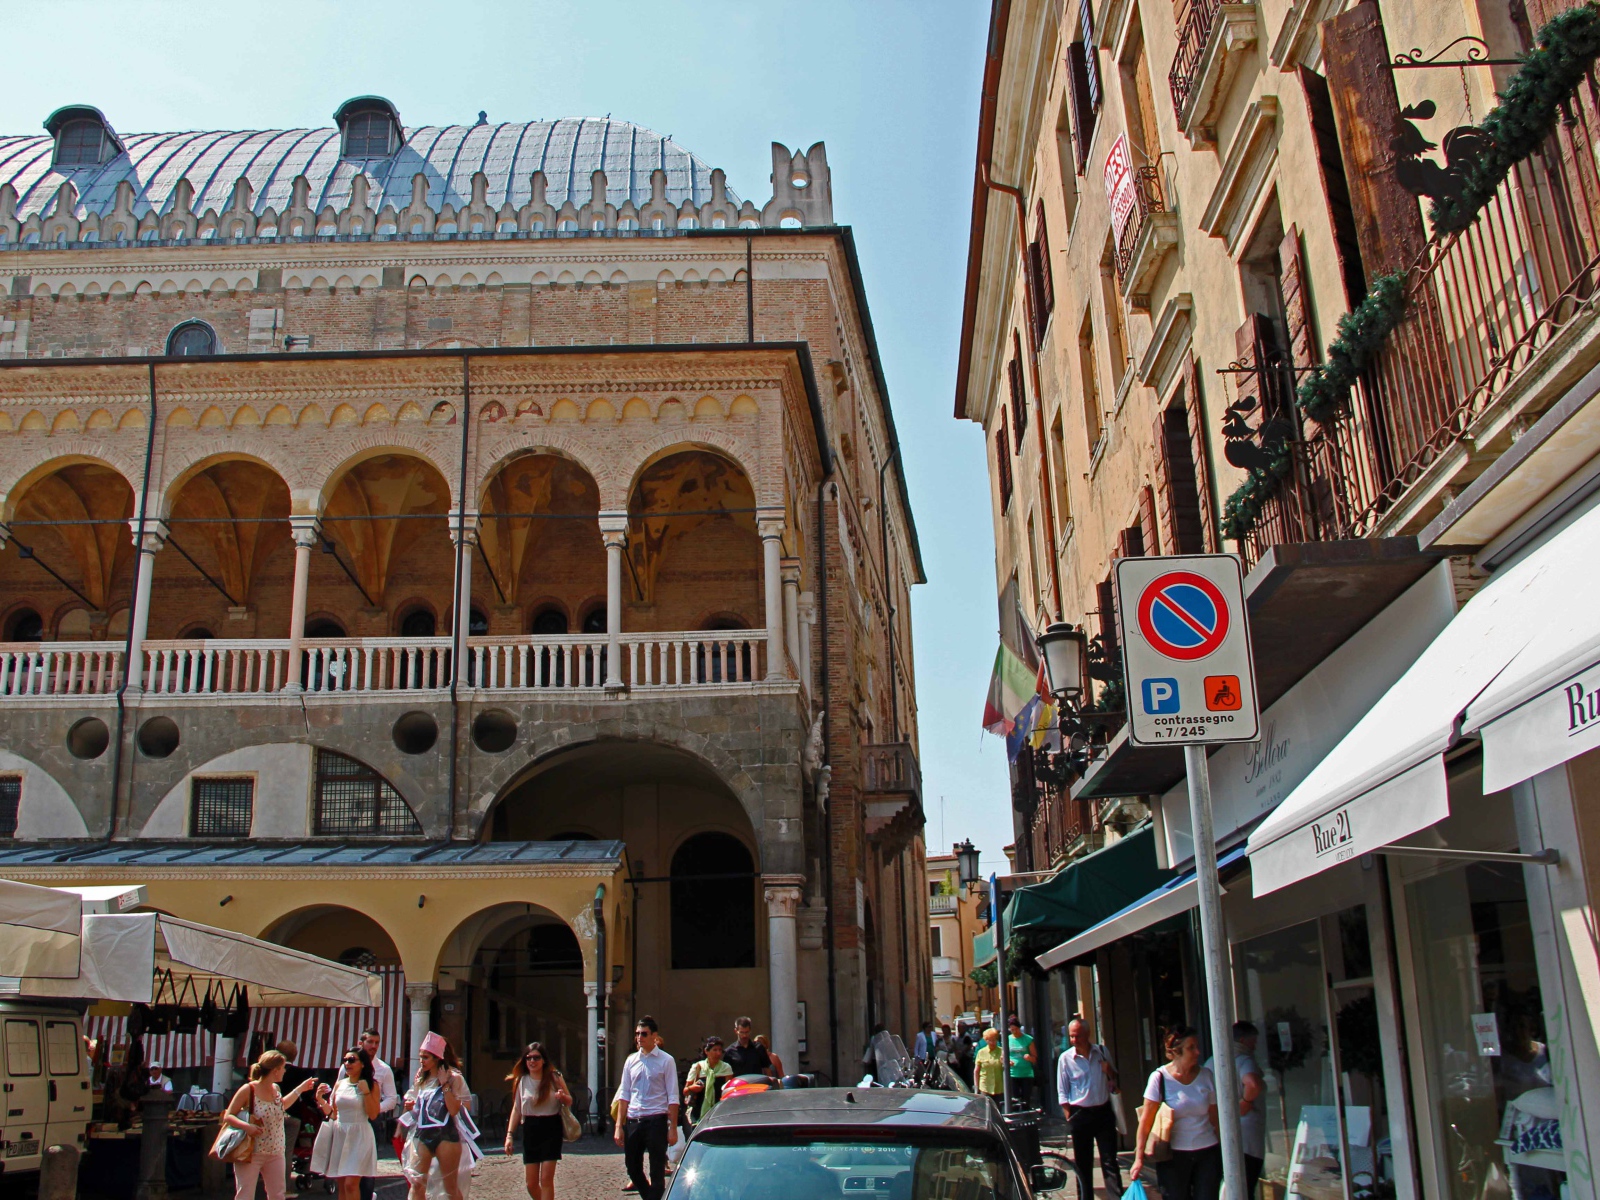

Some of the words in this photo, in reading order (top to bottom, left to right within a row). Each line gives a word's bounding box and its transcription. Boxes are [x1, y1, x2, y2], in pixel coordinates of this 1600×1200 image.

[1150, 682, 1173, 711] P
[1154, 715, 1234, 726] contrassegno
[1155, 730, 1164, 738] n.
[1165, 726, 1206, 738] 7/245
[1244, 719, 1291, 784] Bellora
